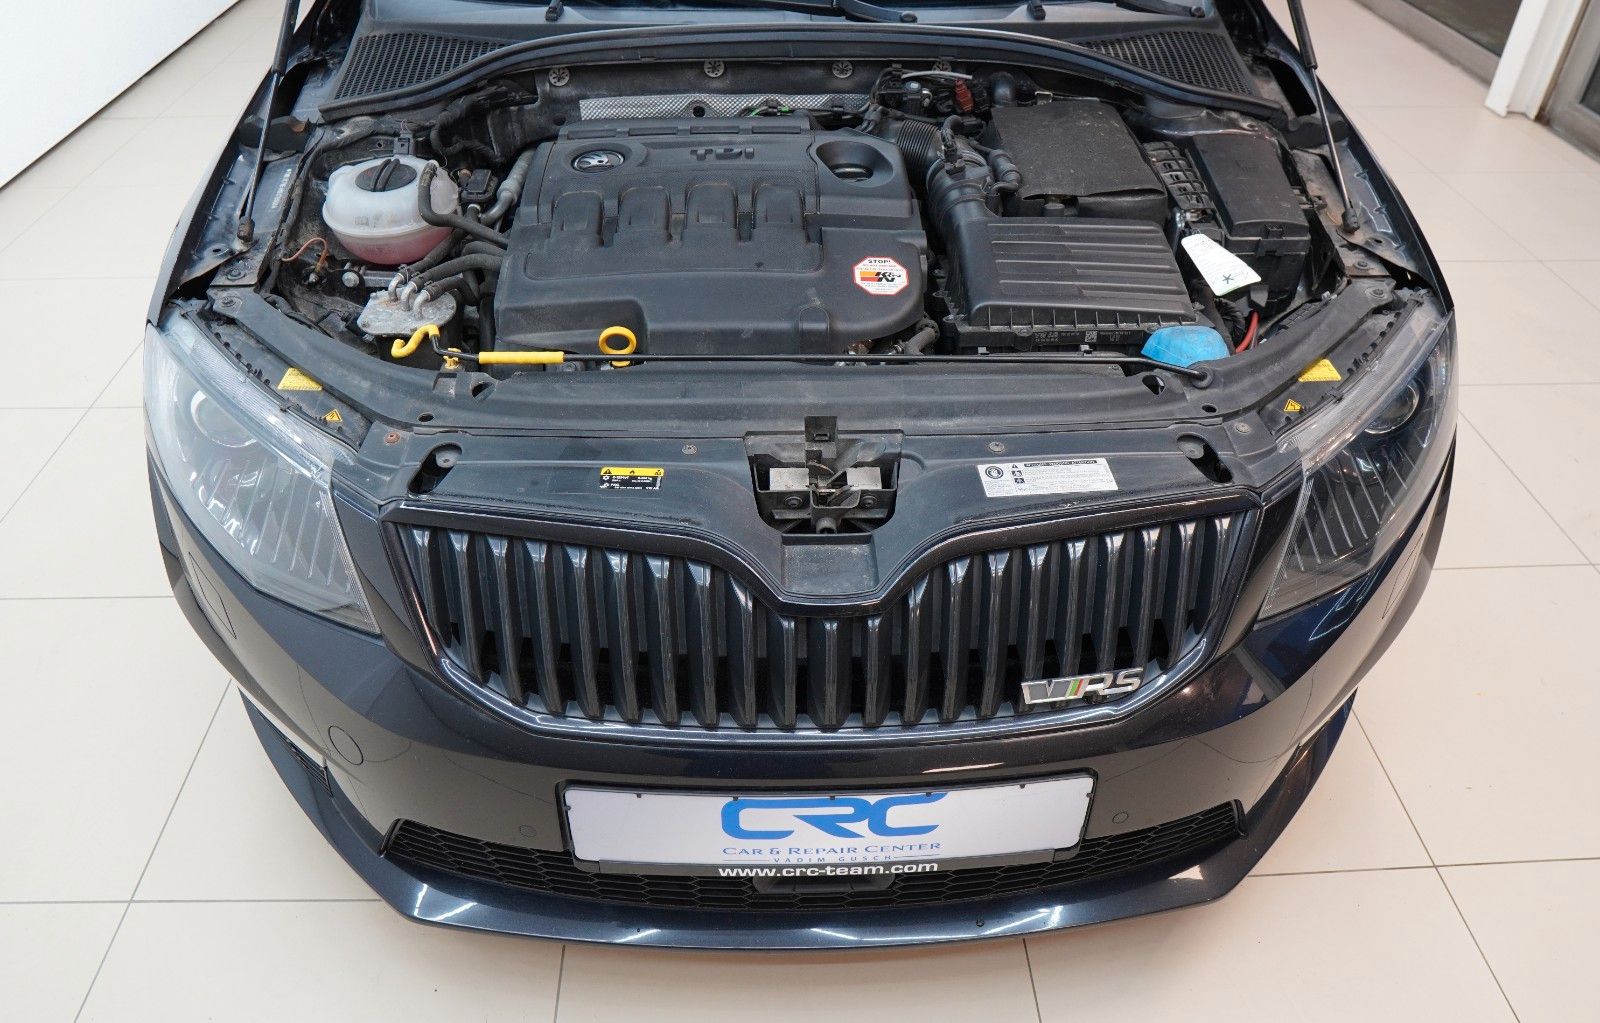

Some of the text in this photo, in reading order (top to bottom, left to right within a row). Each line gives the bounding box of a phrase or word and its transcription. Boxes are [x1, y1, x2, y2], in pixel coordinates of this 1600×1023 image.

[690, 148, 755, 161] TDI
[720, 792, 949, 840] CRC
[722, 847, 763, 855] CAR
[788, 846, 857, 855] REPAIR
[864, 842, 941, 854] CENTER
[718, 863, 939, 877] www.crc-team.com
